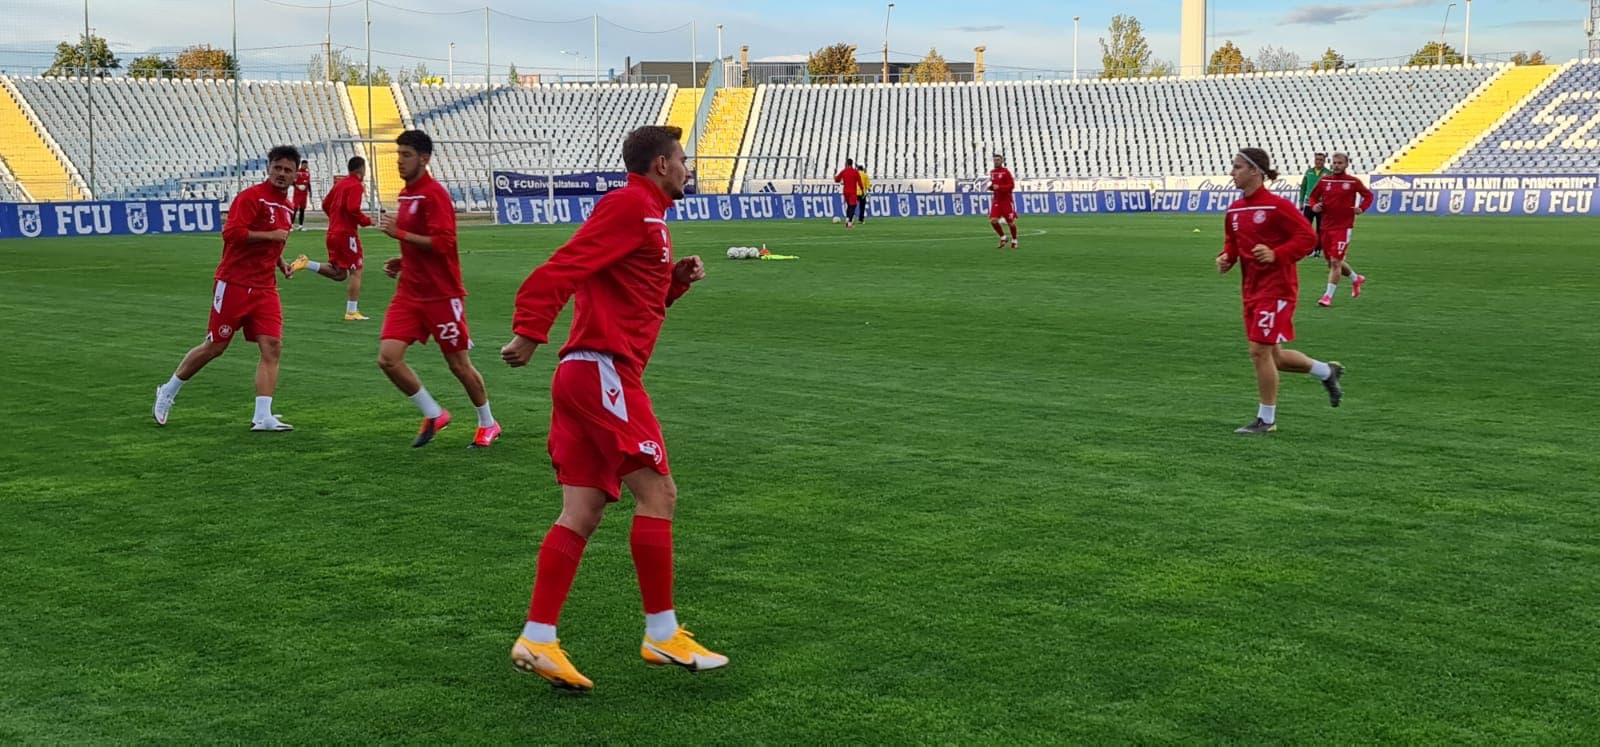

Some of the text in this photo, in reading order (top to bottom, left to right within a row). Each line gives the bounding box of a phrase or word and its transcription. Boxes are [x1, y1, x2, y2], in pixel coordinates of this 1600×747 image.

[530, 199, 571, 223] FCU
[674, 197, 711, 220] FCU
[740, 196, 772, 219] FCU
[804, 195, 834, 218] FCU
[917, 195, 946, 215] FCU
[1023, 194, 1049, 213] FCU
[1072, 193, 1097, 212] FCU
[1120, 191, 1147, 210] FCU
[1153, 191, 1183, 210] FCU
[1400, 191, 1439, 212] FCU
[1473, 191, 1515, 213] FCU
[1548, 190, 1593, 213] FCU
[55, 206, 112, 235] FCU
[161, 203, 214, 232] FCU
[1258, 311, 1275, 328] 21
[437, 322, 460, 340] 23
